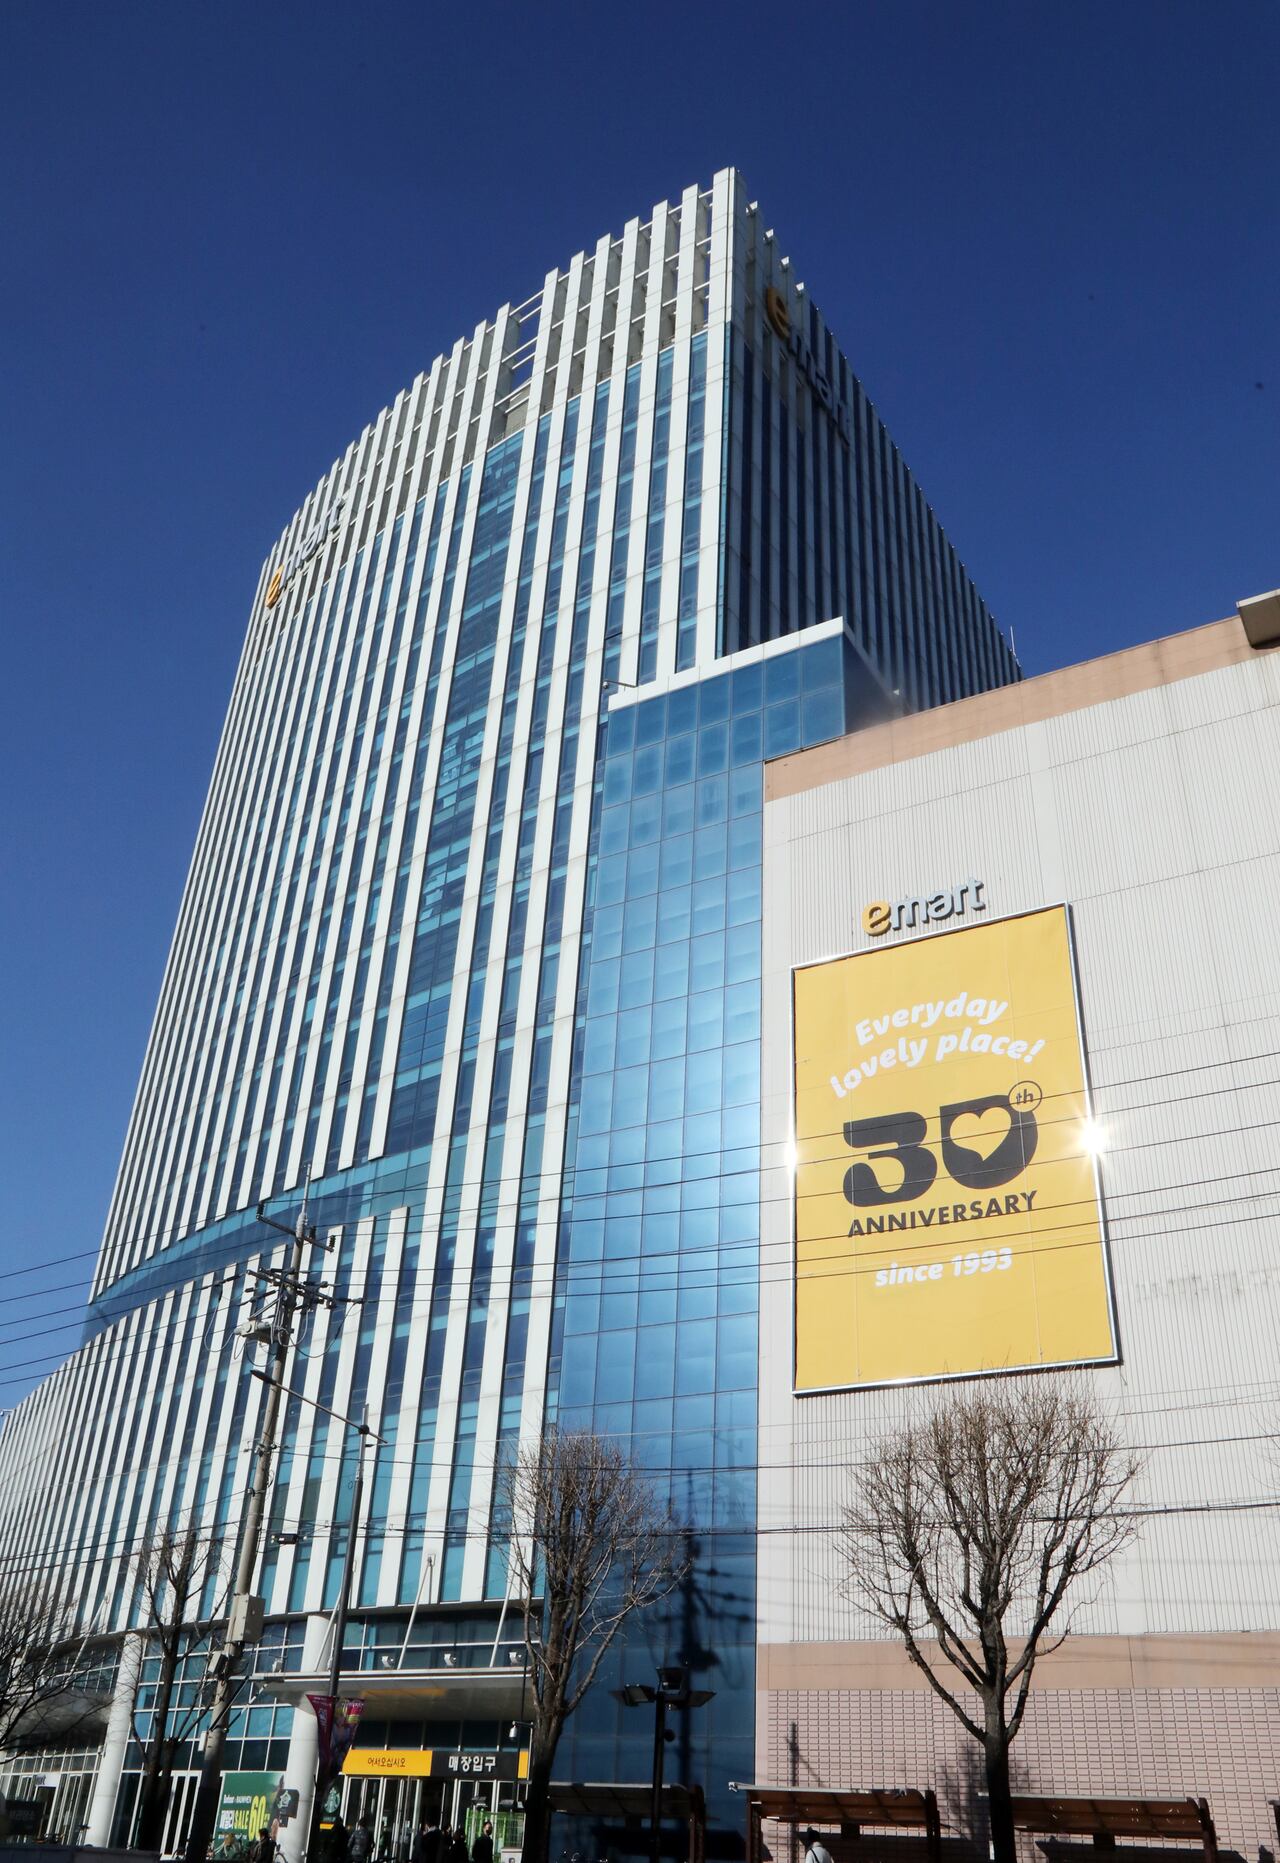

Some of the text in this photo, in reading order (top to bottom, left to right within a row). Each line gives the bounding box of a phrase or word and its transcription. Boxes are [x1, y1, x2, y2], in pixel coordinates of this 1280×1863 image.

[862, 877, 986, 937] emart
[855, 991, 1008, 1047] Everyday
[829, 1026, 1045, 1099] lovely place!
[847, 1190, 1038, 1239] ANNIVERSARY
[874, 1247, 1013, 1288] since 1993
[367, 1756, 406, 1768] 어서오십시오
[448, 1755, 497, 1773] 매장입구
[234, 1810, 250, 1829] SALE
